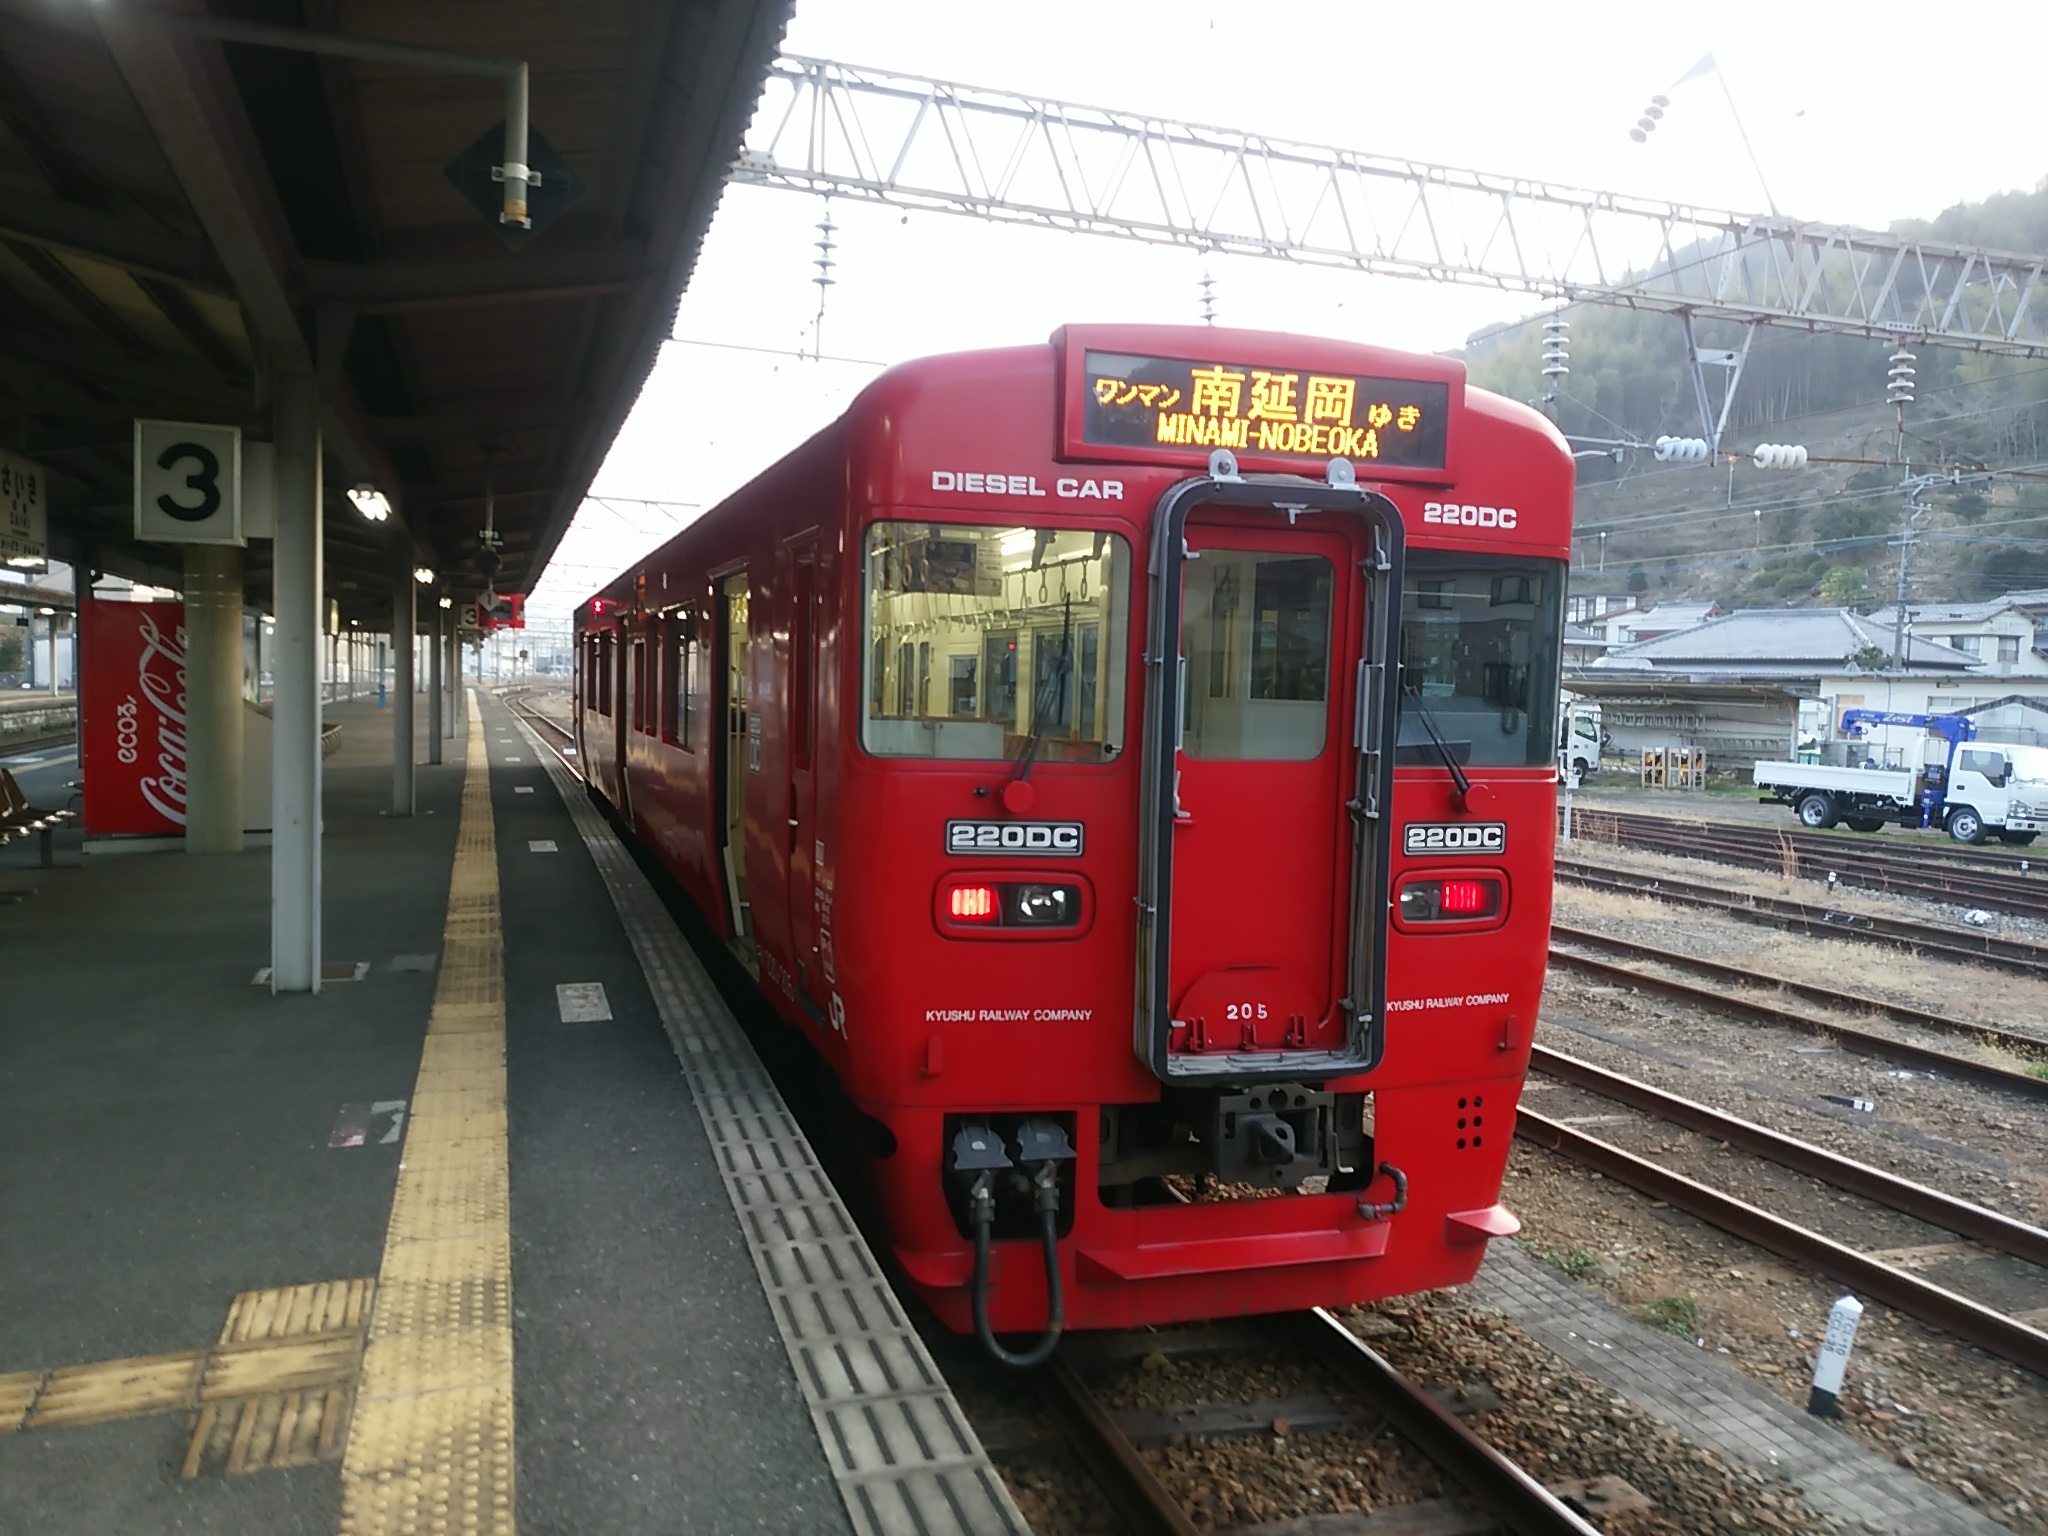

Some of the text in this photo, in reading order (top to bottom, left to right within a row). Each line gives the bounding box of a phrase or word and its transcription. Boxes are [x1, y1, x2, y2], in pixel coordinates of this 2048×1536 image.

[1096, 365, 1421, 431] ワンマン 南延岡 ゆき
[1156, 411, 1379, 458] MINAMI-NOBEOKA
[156, 442, 221, 522] 3
[932, 471, 1124, 500] DIESEL CAR
[1423, 502, 1518, 530] 220DC
[952, 825, 1078, 848] 220DC
[1408, 827, 1502, 847] 220DC
[828, 990, 848, 1041] JR
[926, 1009, 1093, 1021] KYUSHU RAILWAY COMPANY
[1226, 1003, 1268, 1020] 205
[1386, 993, 1510, 1012] KYUSHU RAILWAY COMPANY
